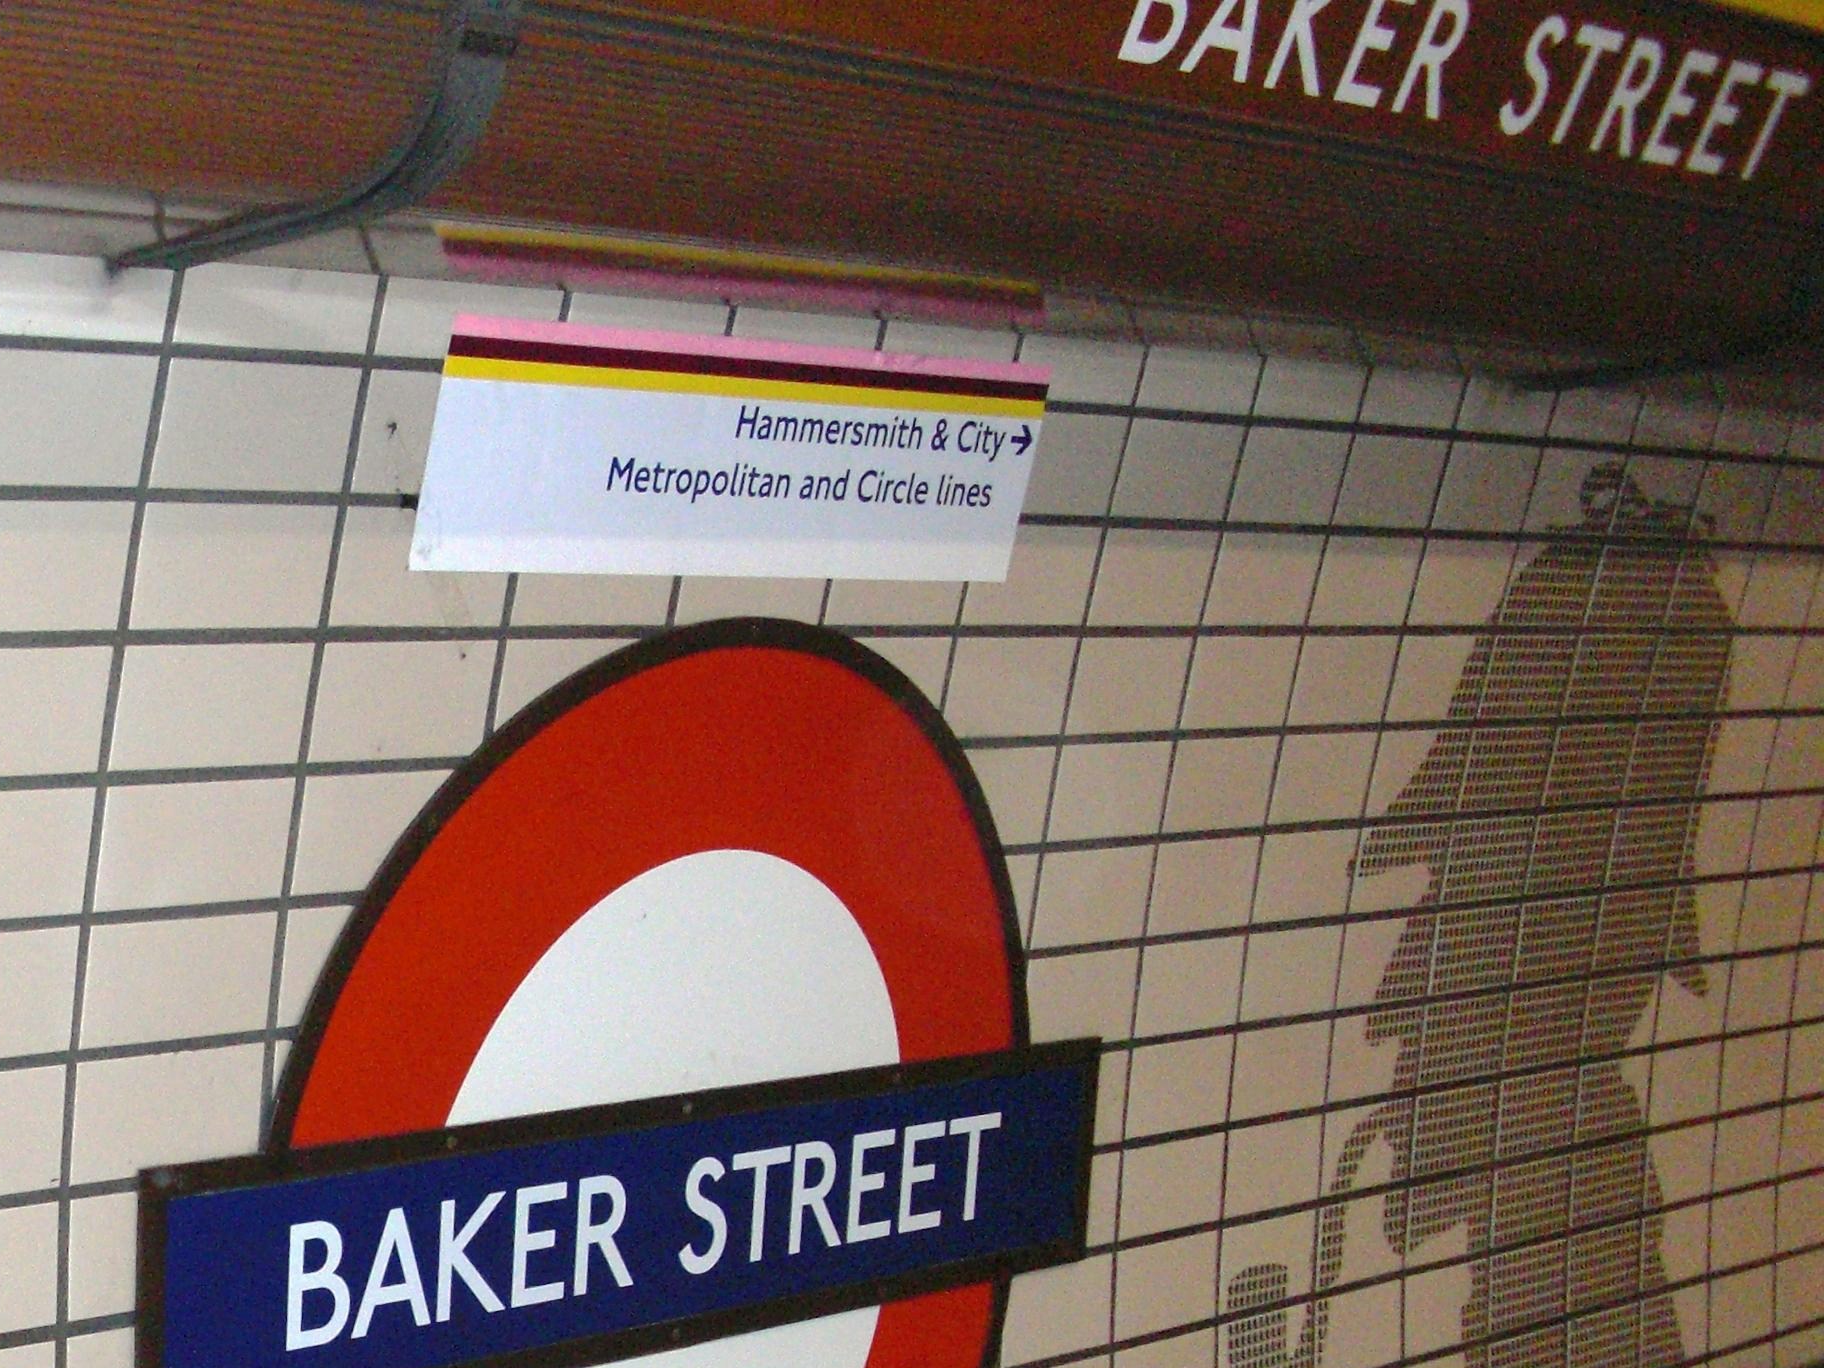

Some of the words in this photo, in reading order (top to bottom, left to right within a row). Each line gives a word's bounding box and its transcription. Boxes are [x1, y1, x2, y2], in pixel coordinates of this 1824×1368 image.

[1117, 0, 1469, 119] BAKER
[1499, 15, 1810, 180] STREET
[605, 457, 790, 503] Metropolitan
[799, 468, 850, 501] and
[856, 470, 927, 505] Circle
[935, 475, 993, 508] lines
[735, 404, 922, 450] Hammersmith
[931, 418, 948, 448] &
[957, 420, 1007, 461] City
[285, 1175, 634, 1351] BAKER
[678, 1112, 1002, 1275] STREET
